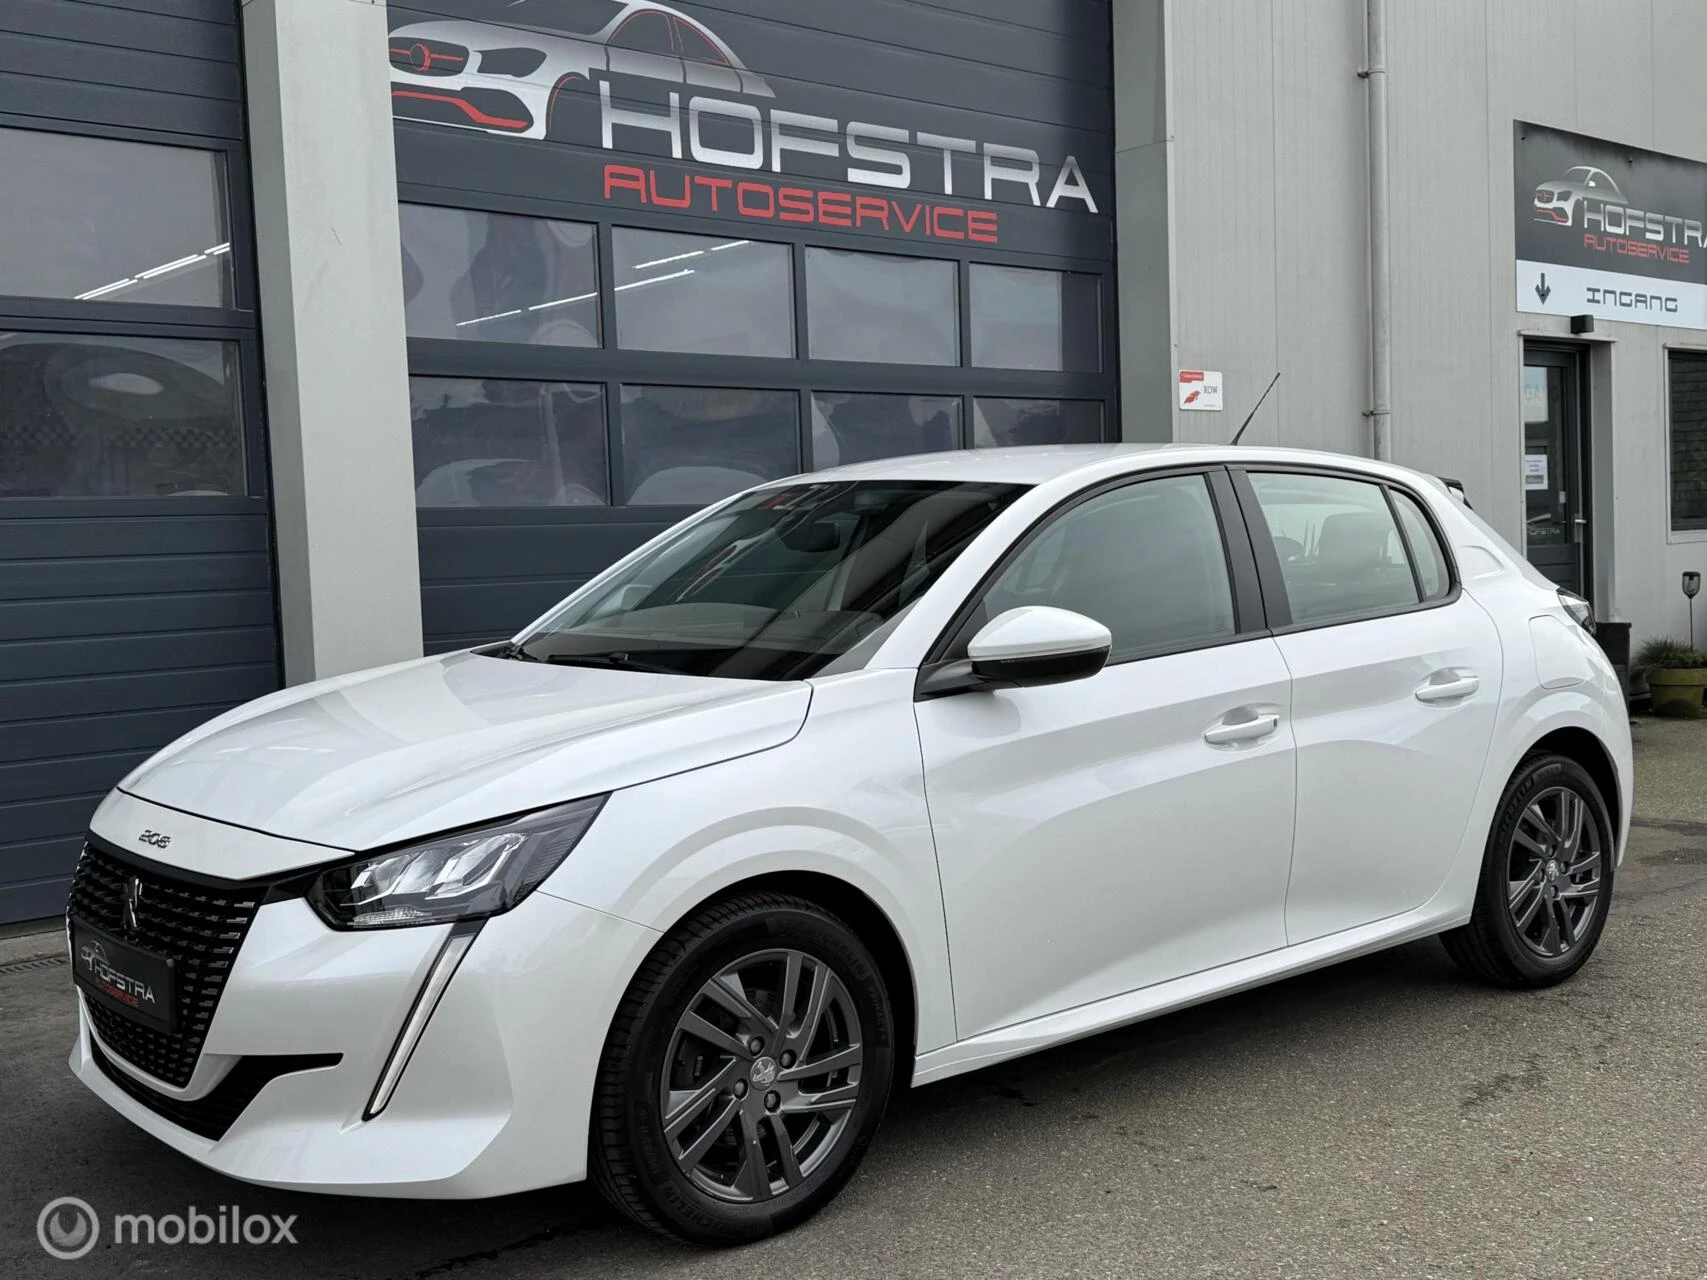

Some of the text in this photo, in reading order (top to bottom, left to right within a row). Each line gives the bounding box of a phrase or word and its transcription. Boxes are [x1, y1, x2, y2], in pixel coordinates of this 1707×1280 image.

[599, 79, 1099, 214] HOFSTRA
[604, 165, 999, 245] AUTOSERVICE
[1584, 200, 1707, 248] HOFSTR
[1584, 233, 1690, 264] AUTOSERVICE
[1586, 286, 1678, 313] INGANG
[138, 829, 171, 849] 208
[94, 958, 156, 1004] HOFSTRA
